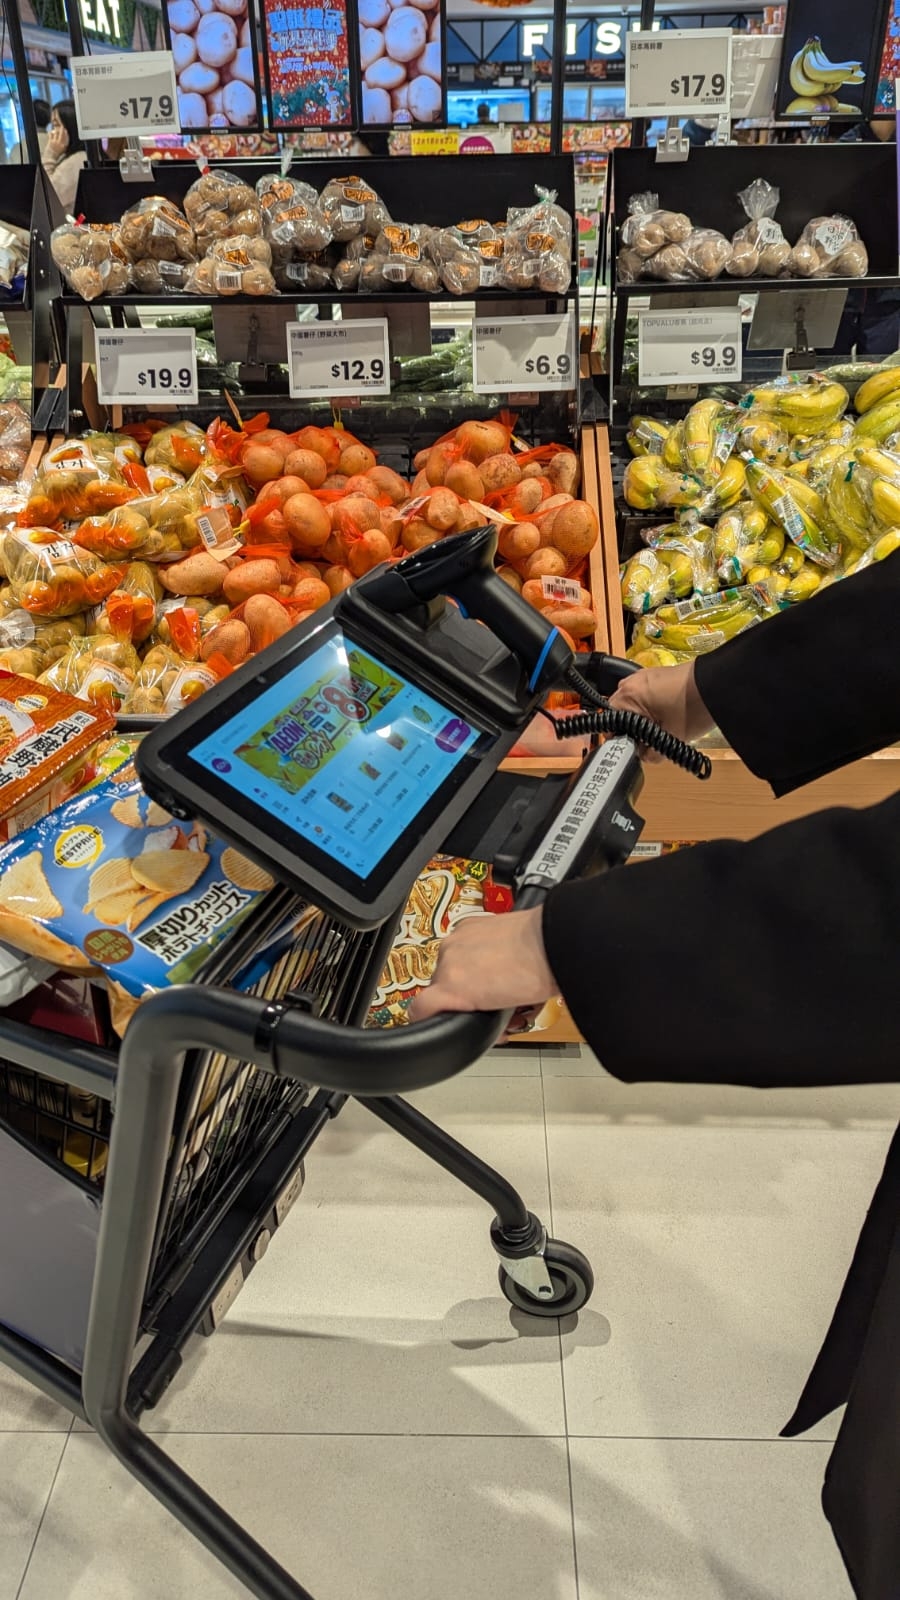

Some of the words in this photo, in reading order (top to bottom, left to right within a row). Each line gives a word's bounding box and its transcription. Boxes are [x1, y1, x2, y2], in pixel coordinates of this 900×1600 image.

[62, 0, 120, 38] EAT
[522, 22, 660, 57] FIS
[671, 73, 725, 98] $17.9
[120, 94, 173, 119] $17.9
[331, 359, 384, 381] $12.9
[525, 354, 571, 375] $6.9
[690, 346, 736, 367] $9.9
[138, 368, 192, 388] $19.9
[270, 719, 310, 754] AEON
[55, 827, 103, 867] BESTPRICE
[137, 881, 231, 951] 厚切りカット
[159, 891, 249, 962] ポテトチップス
